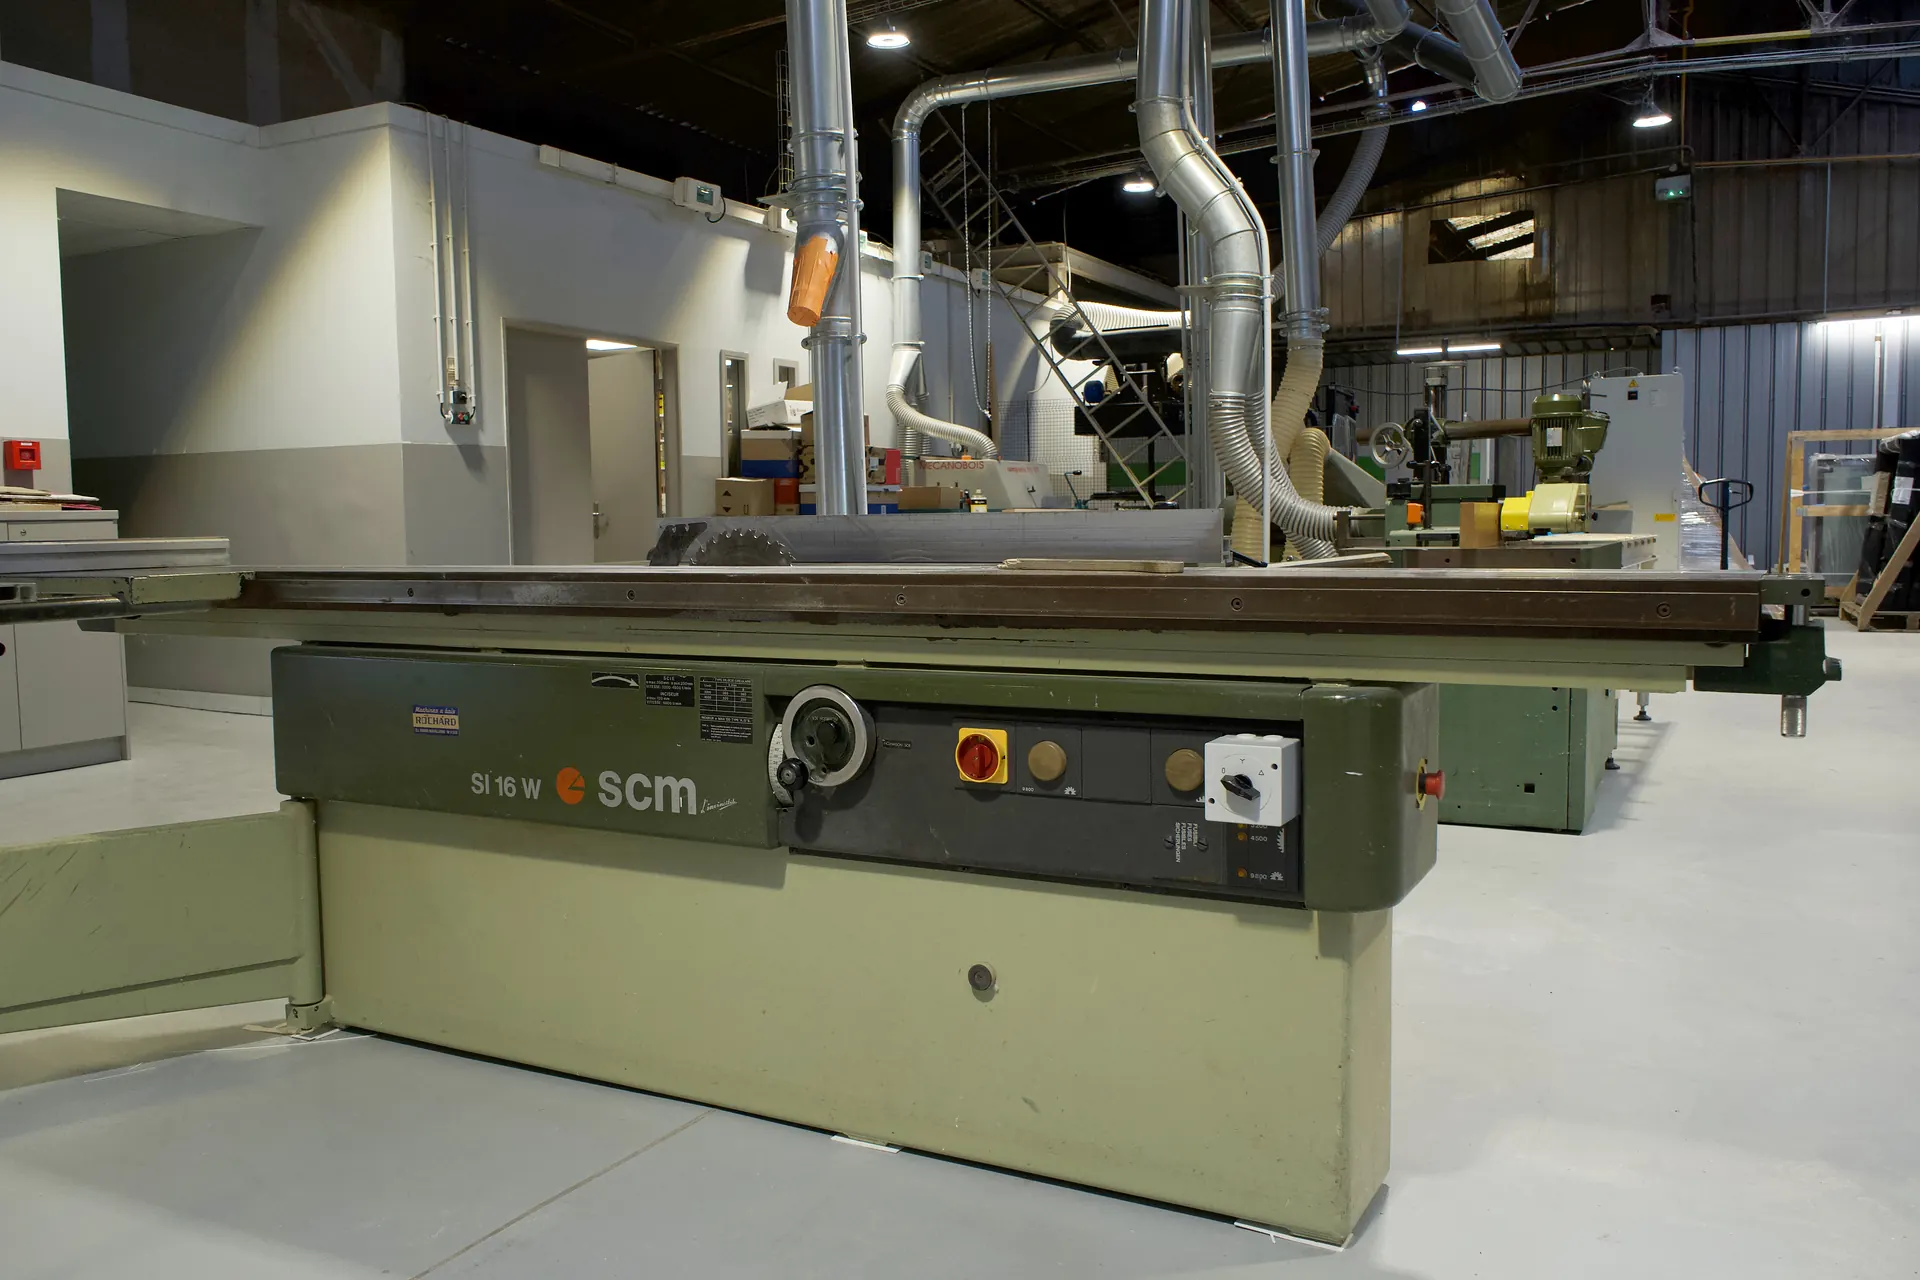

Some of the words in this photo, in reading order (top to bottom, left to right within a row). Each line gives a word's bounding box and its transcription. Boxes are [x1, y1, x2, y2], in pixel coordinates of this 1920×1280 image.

[920, 460, 985, 470] MECANOBOIS
[471, 772, 490, 795] SI
[495, 776, 517, 798] 16
[521, 777, 542, 800] W
